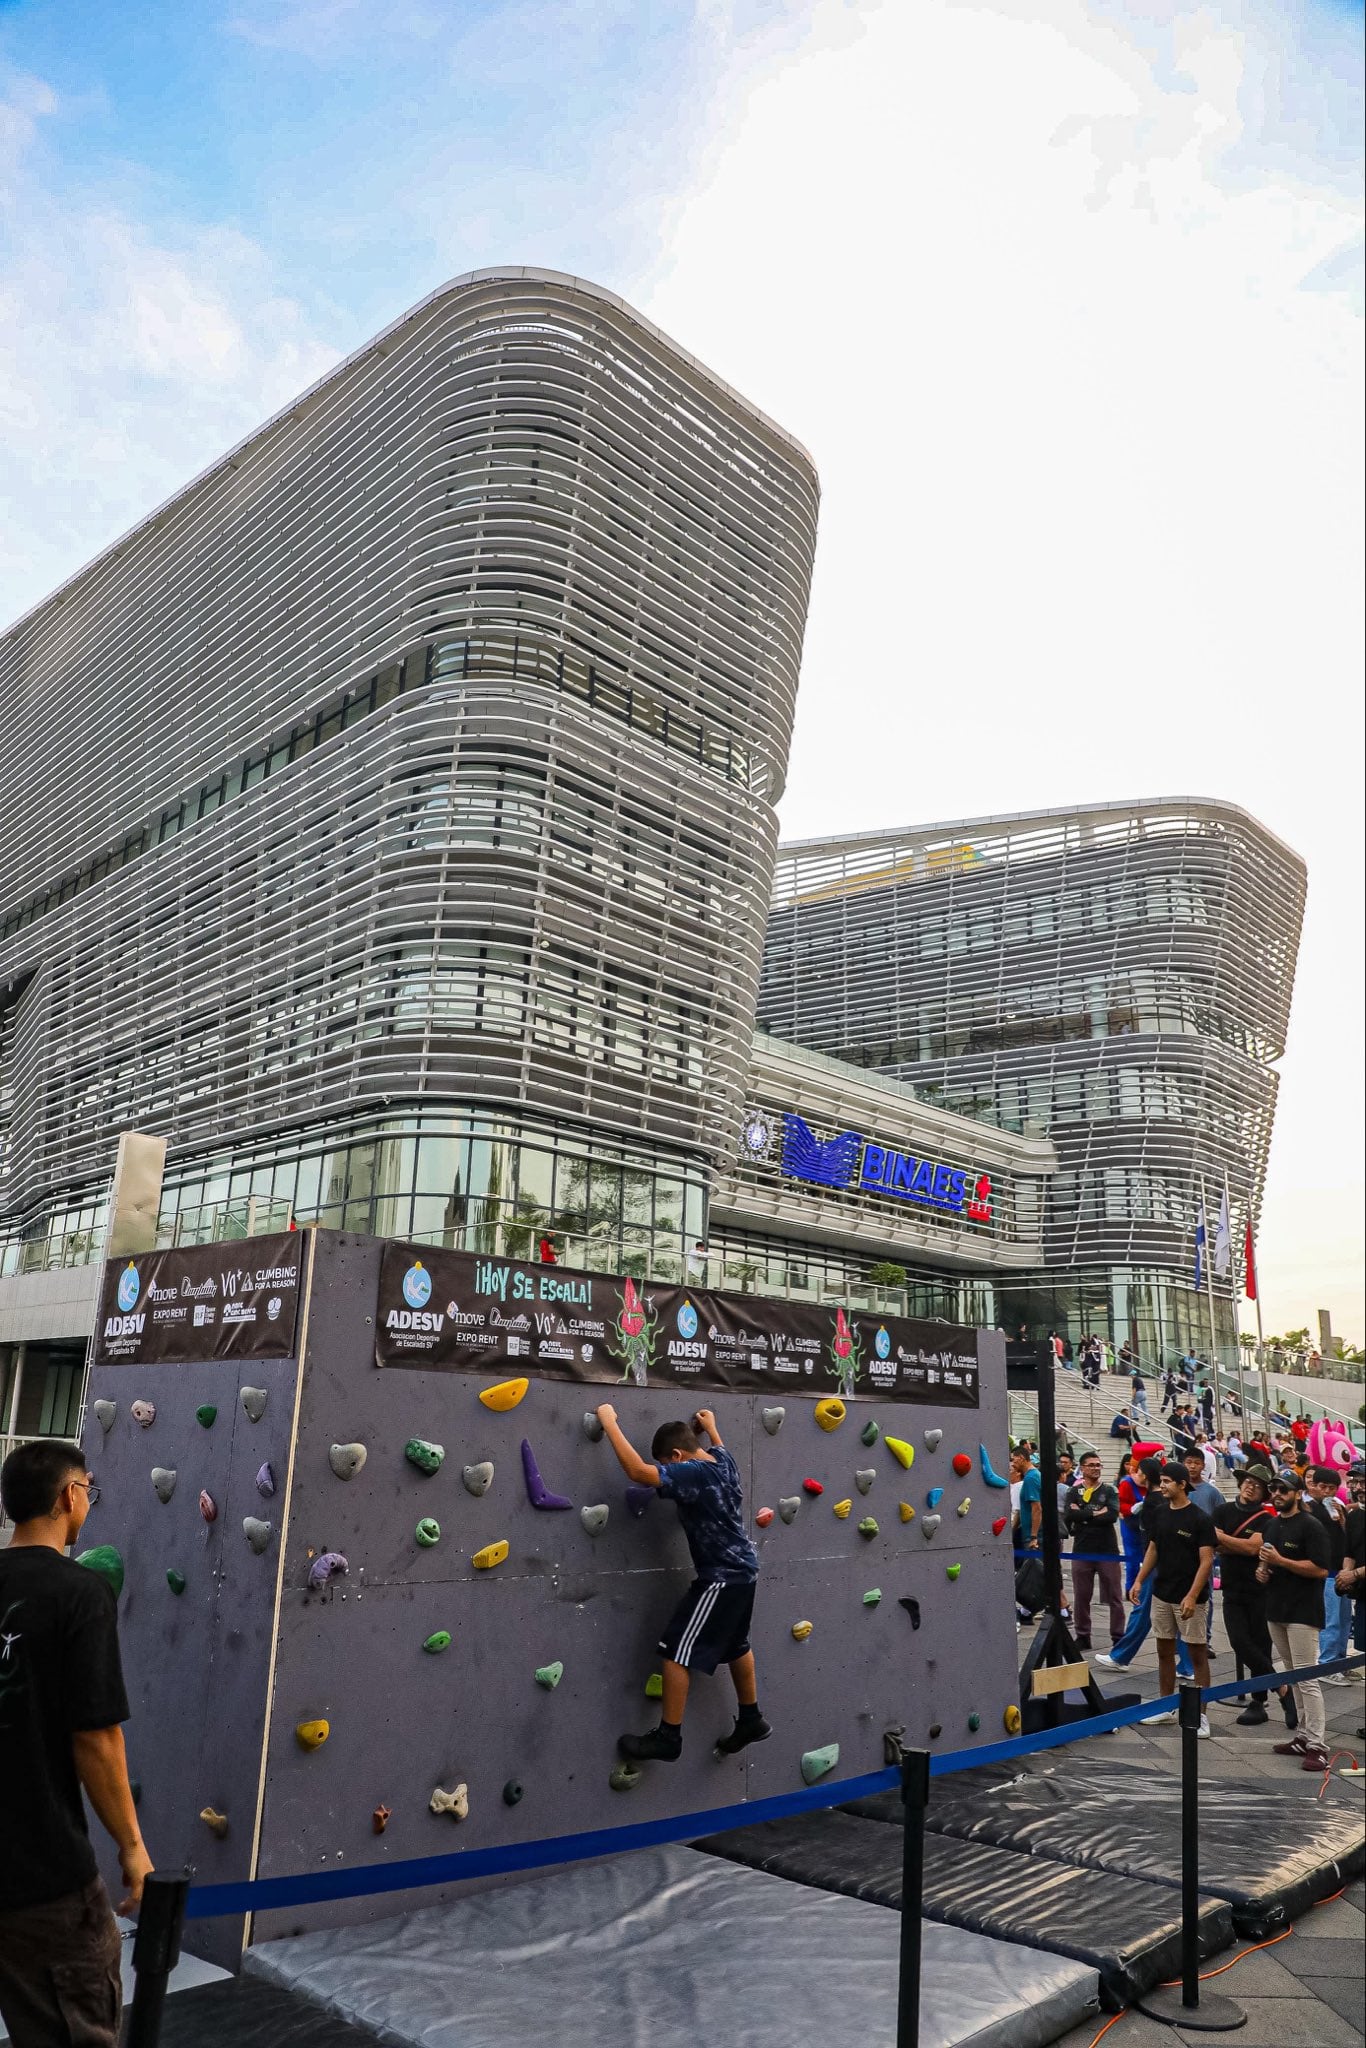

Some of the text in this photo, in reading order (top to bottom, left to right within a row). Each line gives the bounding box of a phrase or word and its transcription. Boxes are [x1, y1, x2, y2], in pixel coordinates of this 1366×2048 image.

[862, 1144, 967, 1203] BINAES
[255, 1266, 297, 1281] CLIMBING
[254, 1281, 266, 1290] FOR
[272, 1279, 296, 1288] REASON
[512, 1270, 535, 1300] SE
[540, 1276, 592, 1311] ESCALA!
[153, 1287, 178, 1302] move
[153, 1309, 171, 1320] EXPO
[171, 1308, 188, 1318] RENT
[385, 1310, 444, 1332] ADESV
[454, 1310, 485, 1326] move
[104, 1313, 146, 1337] ADESV
[569, 1318, 605, 1332] CLIMBING
[456, 1332, 499, 1345] EXPO RENT
[584, 1330, 605, 1338] REASON
[667, 1340, 707, 1359] ADESV
[795, 1338, 821, 1348] CLIMBING
[715, 1351, 746, 1361] EXPO RENT
[869, 1360, 898, 1375] ADESV
